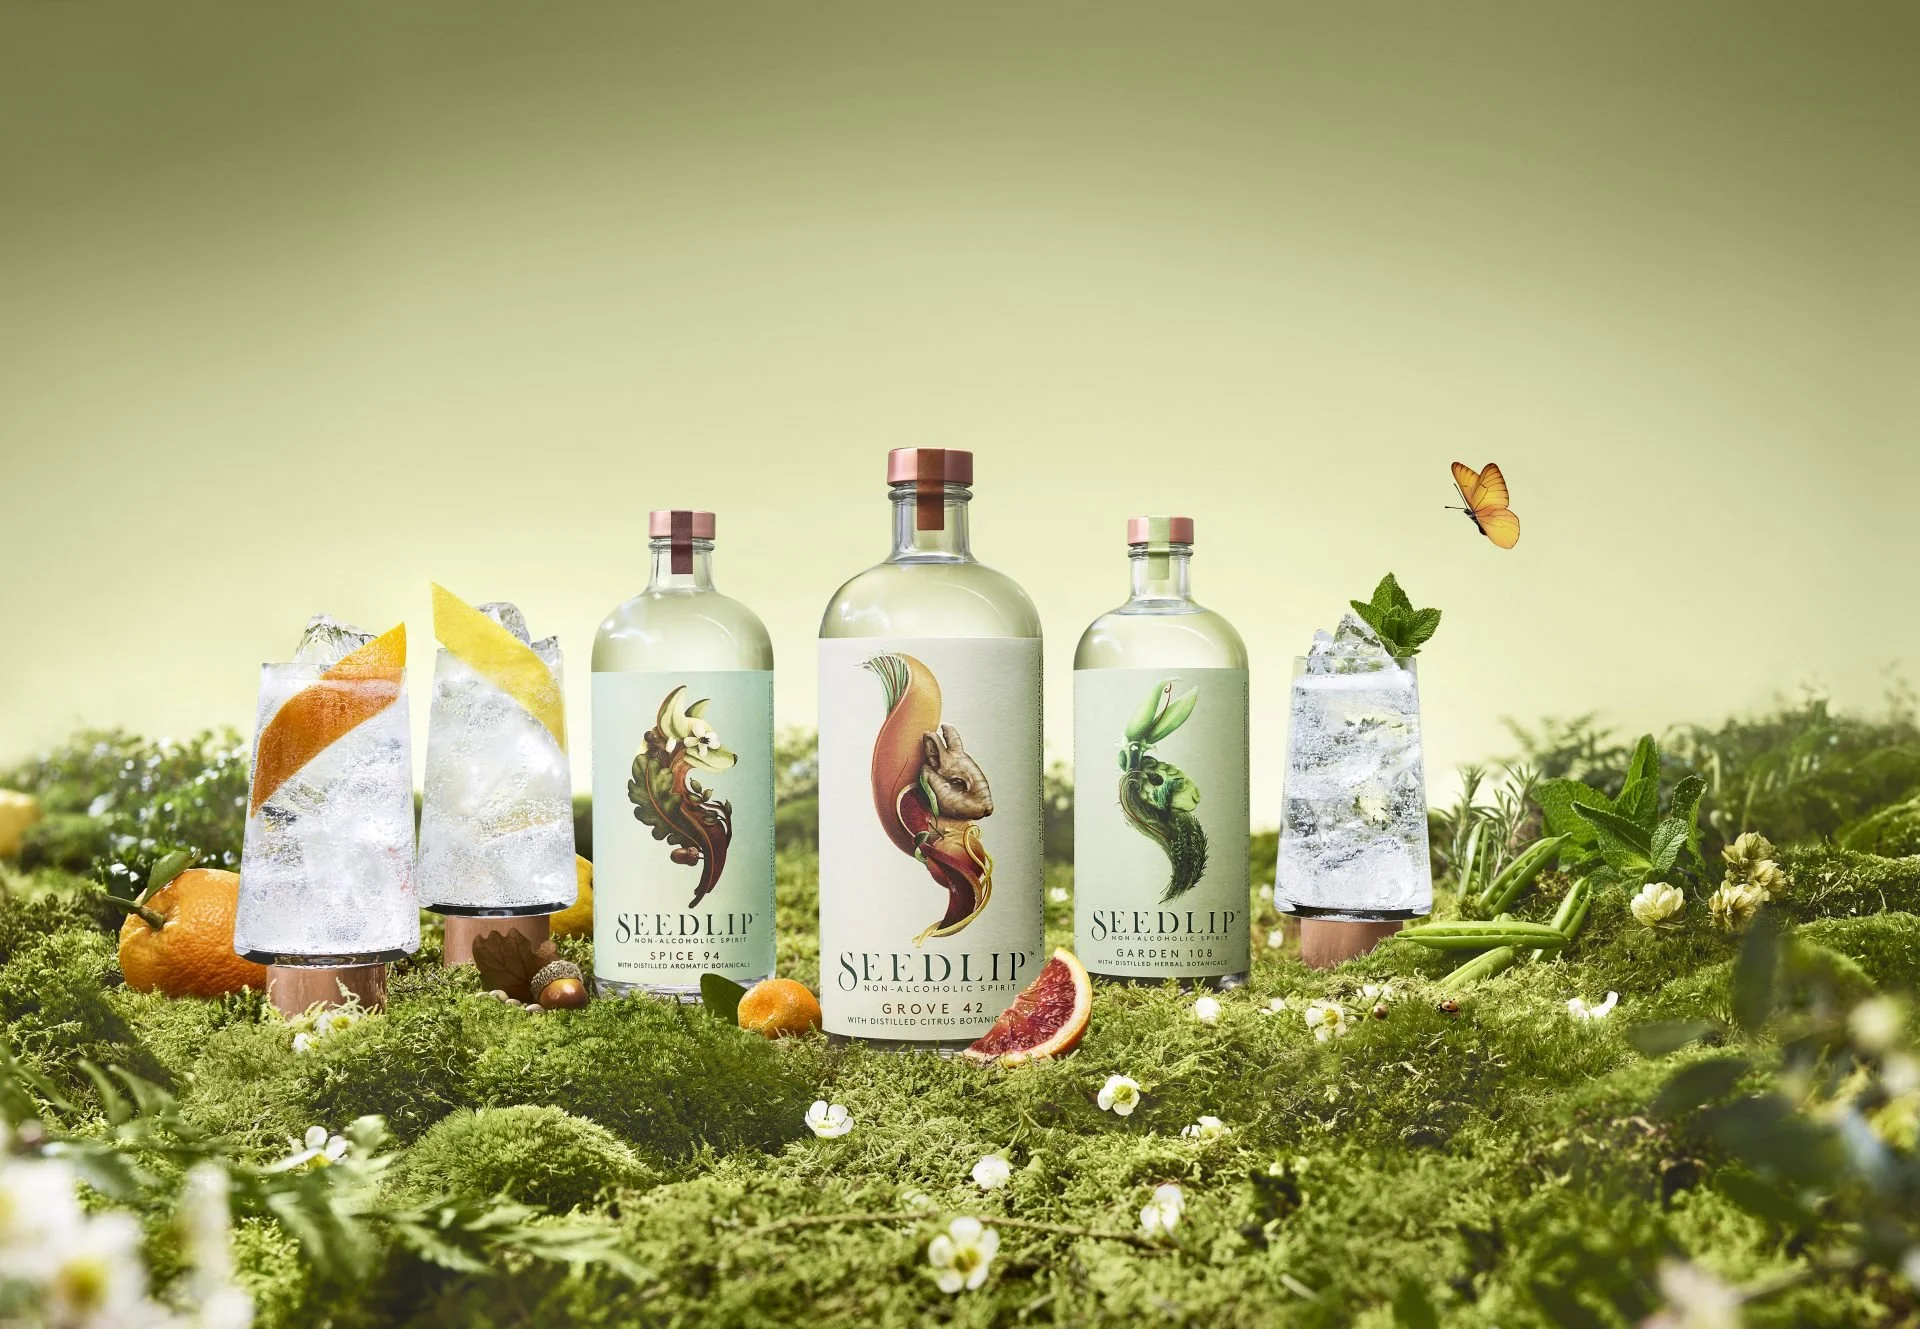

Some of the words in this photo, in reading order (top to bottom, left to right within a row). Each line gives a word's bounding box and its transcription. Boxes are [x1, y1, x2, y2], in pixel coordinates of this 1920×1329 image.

[615, 912, 753, 944] SEEDLIP
[720, 936, 747, 944] SPIRIT
[650, 951, 694, 961] SPICE
[703, 951, 720, 960] 94
[1116, 948, 1179, 958] GARDEN
[1189, 948, 1213, 958] 108
[634, 962, 668, 970] DISTILLED
[670, 962, 709, 970] AROMATIC
[711, 961, 751, 969] BOTANICALS
[1186, 959, 1228, 967] BOTANICALS
[864, 984, 973, 993] NON-ALCOHOLIC
[980, 983, 1017, 992] SPIRIT
[881, 1003, 950, 1015] GROVE
[962, 1002, 983, 1014] 42
[847, 1016, 867, 1025] WITH
[870, 1017, 916, 1026] DISTILLED
[920, 1017, 956, 1026] CITRUS
[959, 1015, 1000, 1025] BOTANIC
